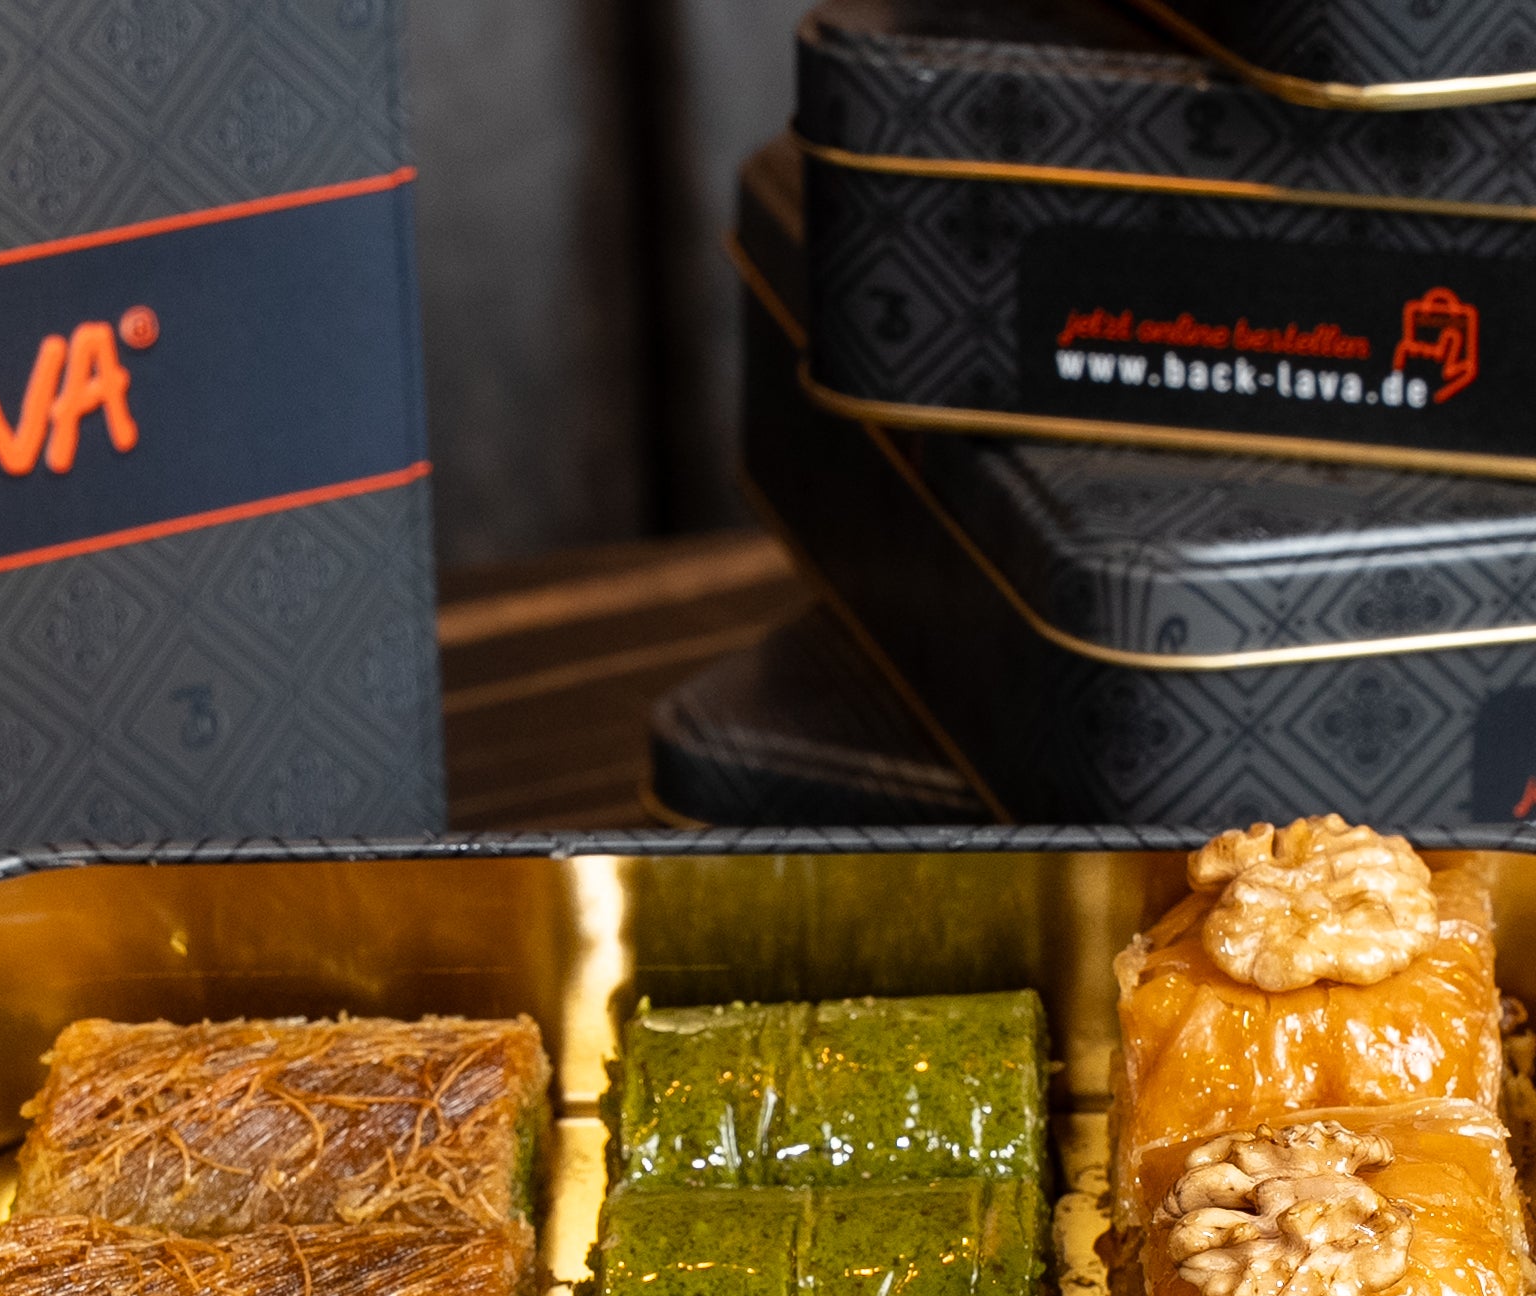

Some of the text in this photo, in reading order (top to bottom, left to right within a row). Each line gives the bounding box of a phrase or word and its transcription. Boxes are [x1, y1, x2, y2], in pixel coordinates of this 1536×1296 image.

[1136, 312, 1231, 350] online
[1232, 317, 1371, 360] bestellen
[1056, 350, 1428, 409] www.back-lava.de
